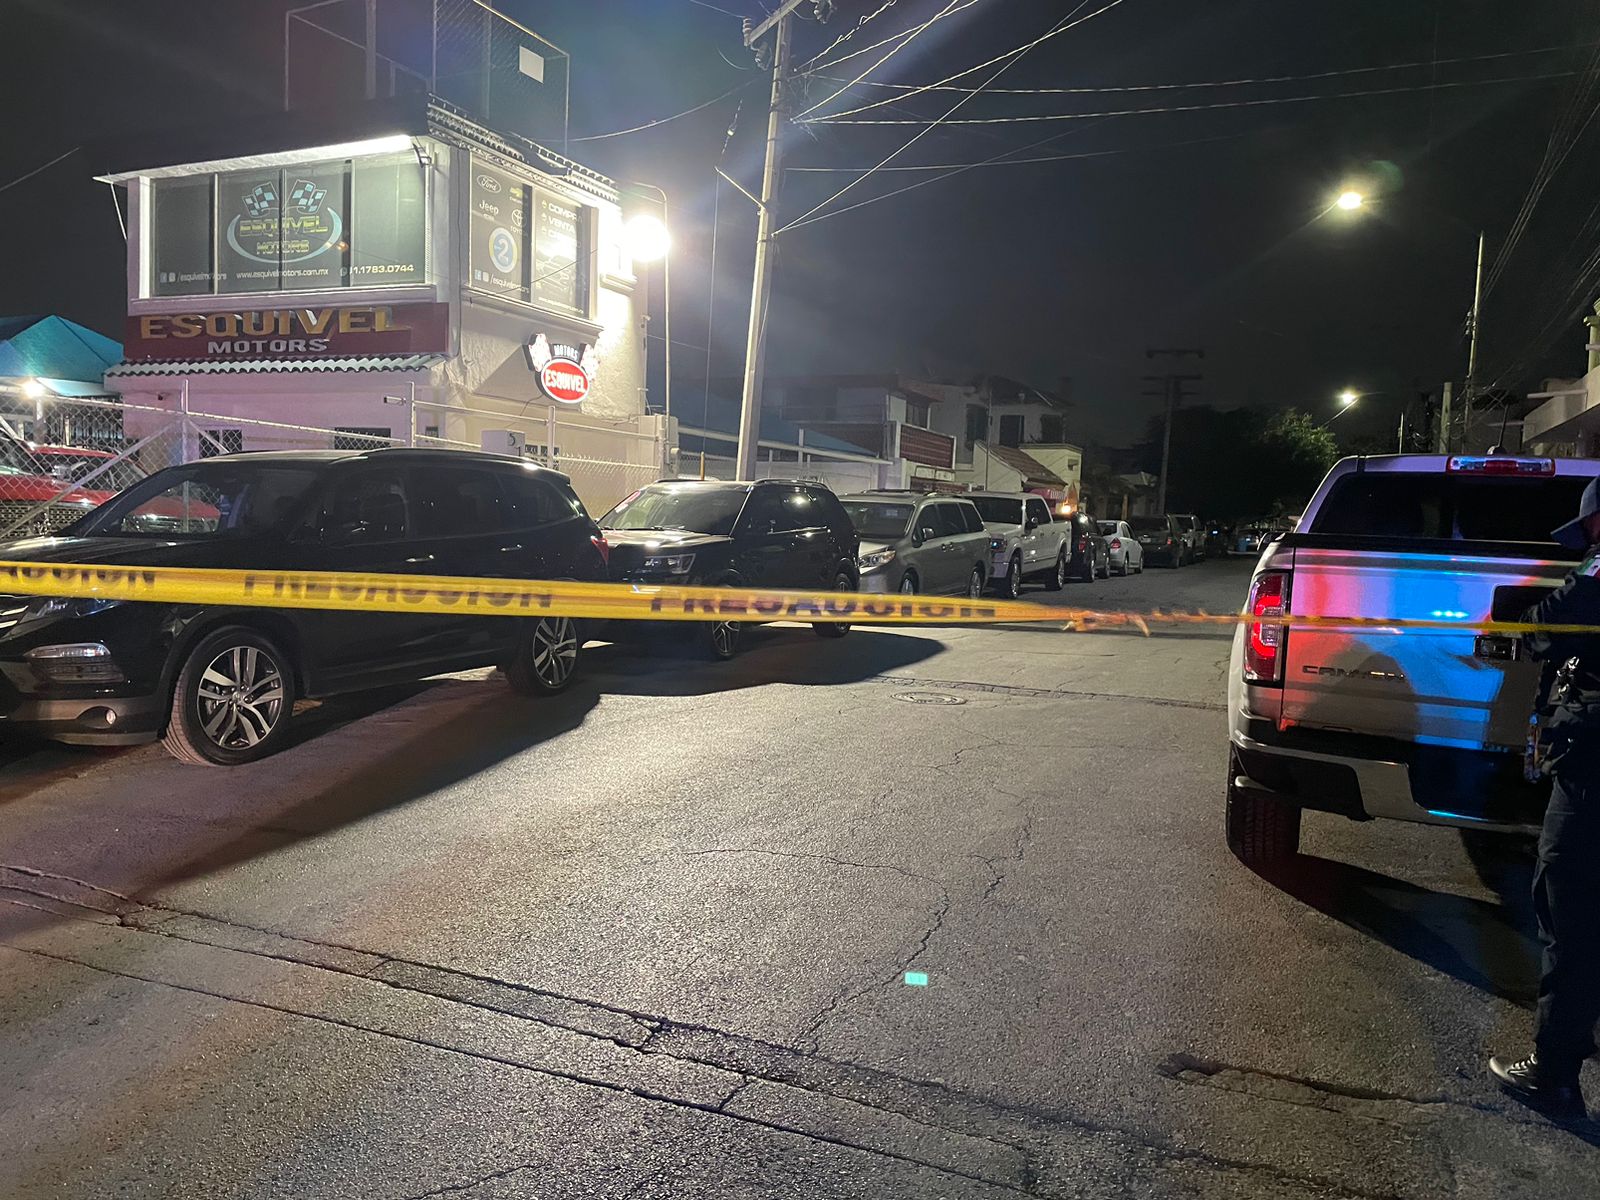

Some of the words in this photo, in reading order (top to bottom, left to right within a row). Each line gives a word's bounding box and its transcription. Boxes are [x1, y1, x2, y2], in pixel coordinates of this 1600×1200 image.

[479, 200, 499, 216] Jeep
[240, 215, 328, 237] ESQUIVEL
[256, 240, 310, 255] MOTORS
[236, 265, 329, 281] www.esquivelotors.com.mx
[350, 263, 415, 275] 1.1783.0744
[140, 307, 411, 339] ESQUIVEL
[207, 338, 329, 354] MOTORS
[553, 344, 580, 362] MOTORS
[545, 368, 587, 393] ESQUIVEL
